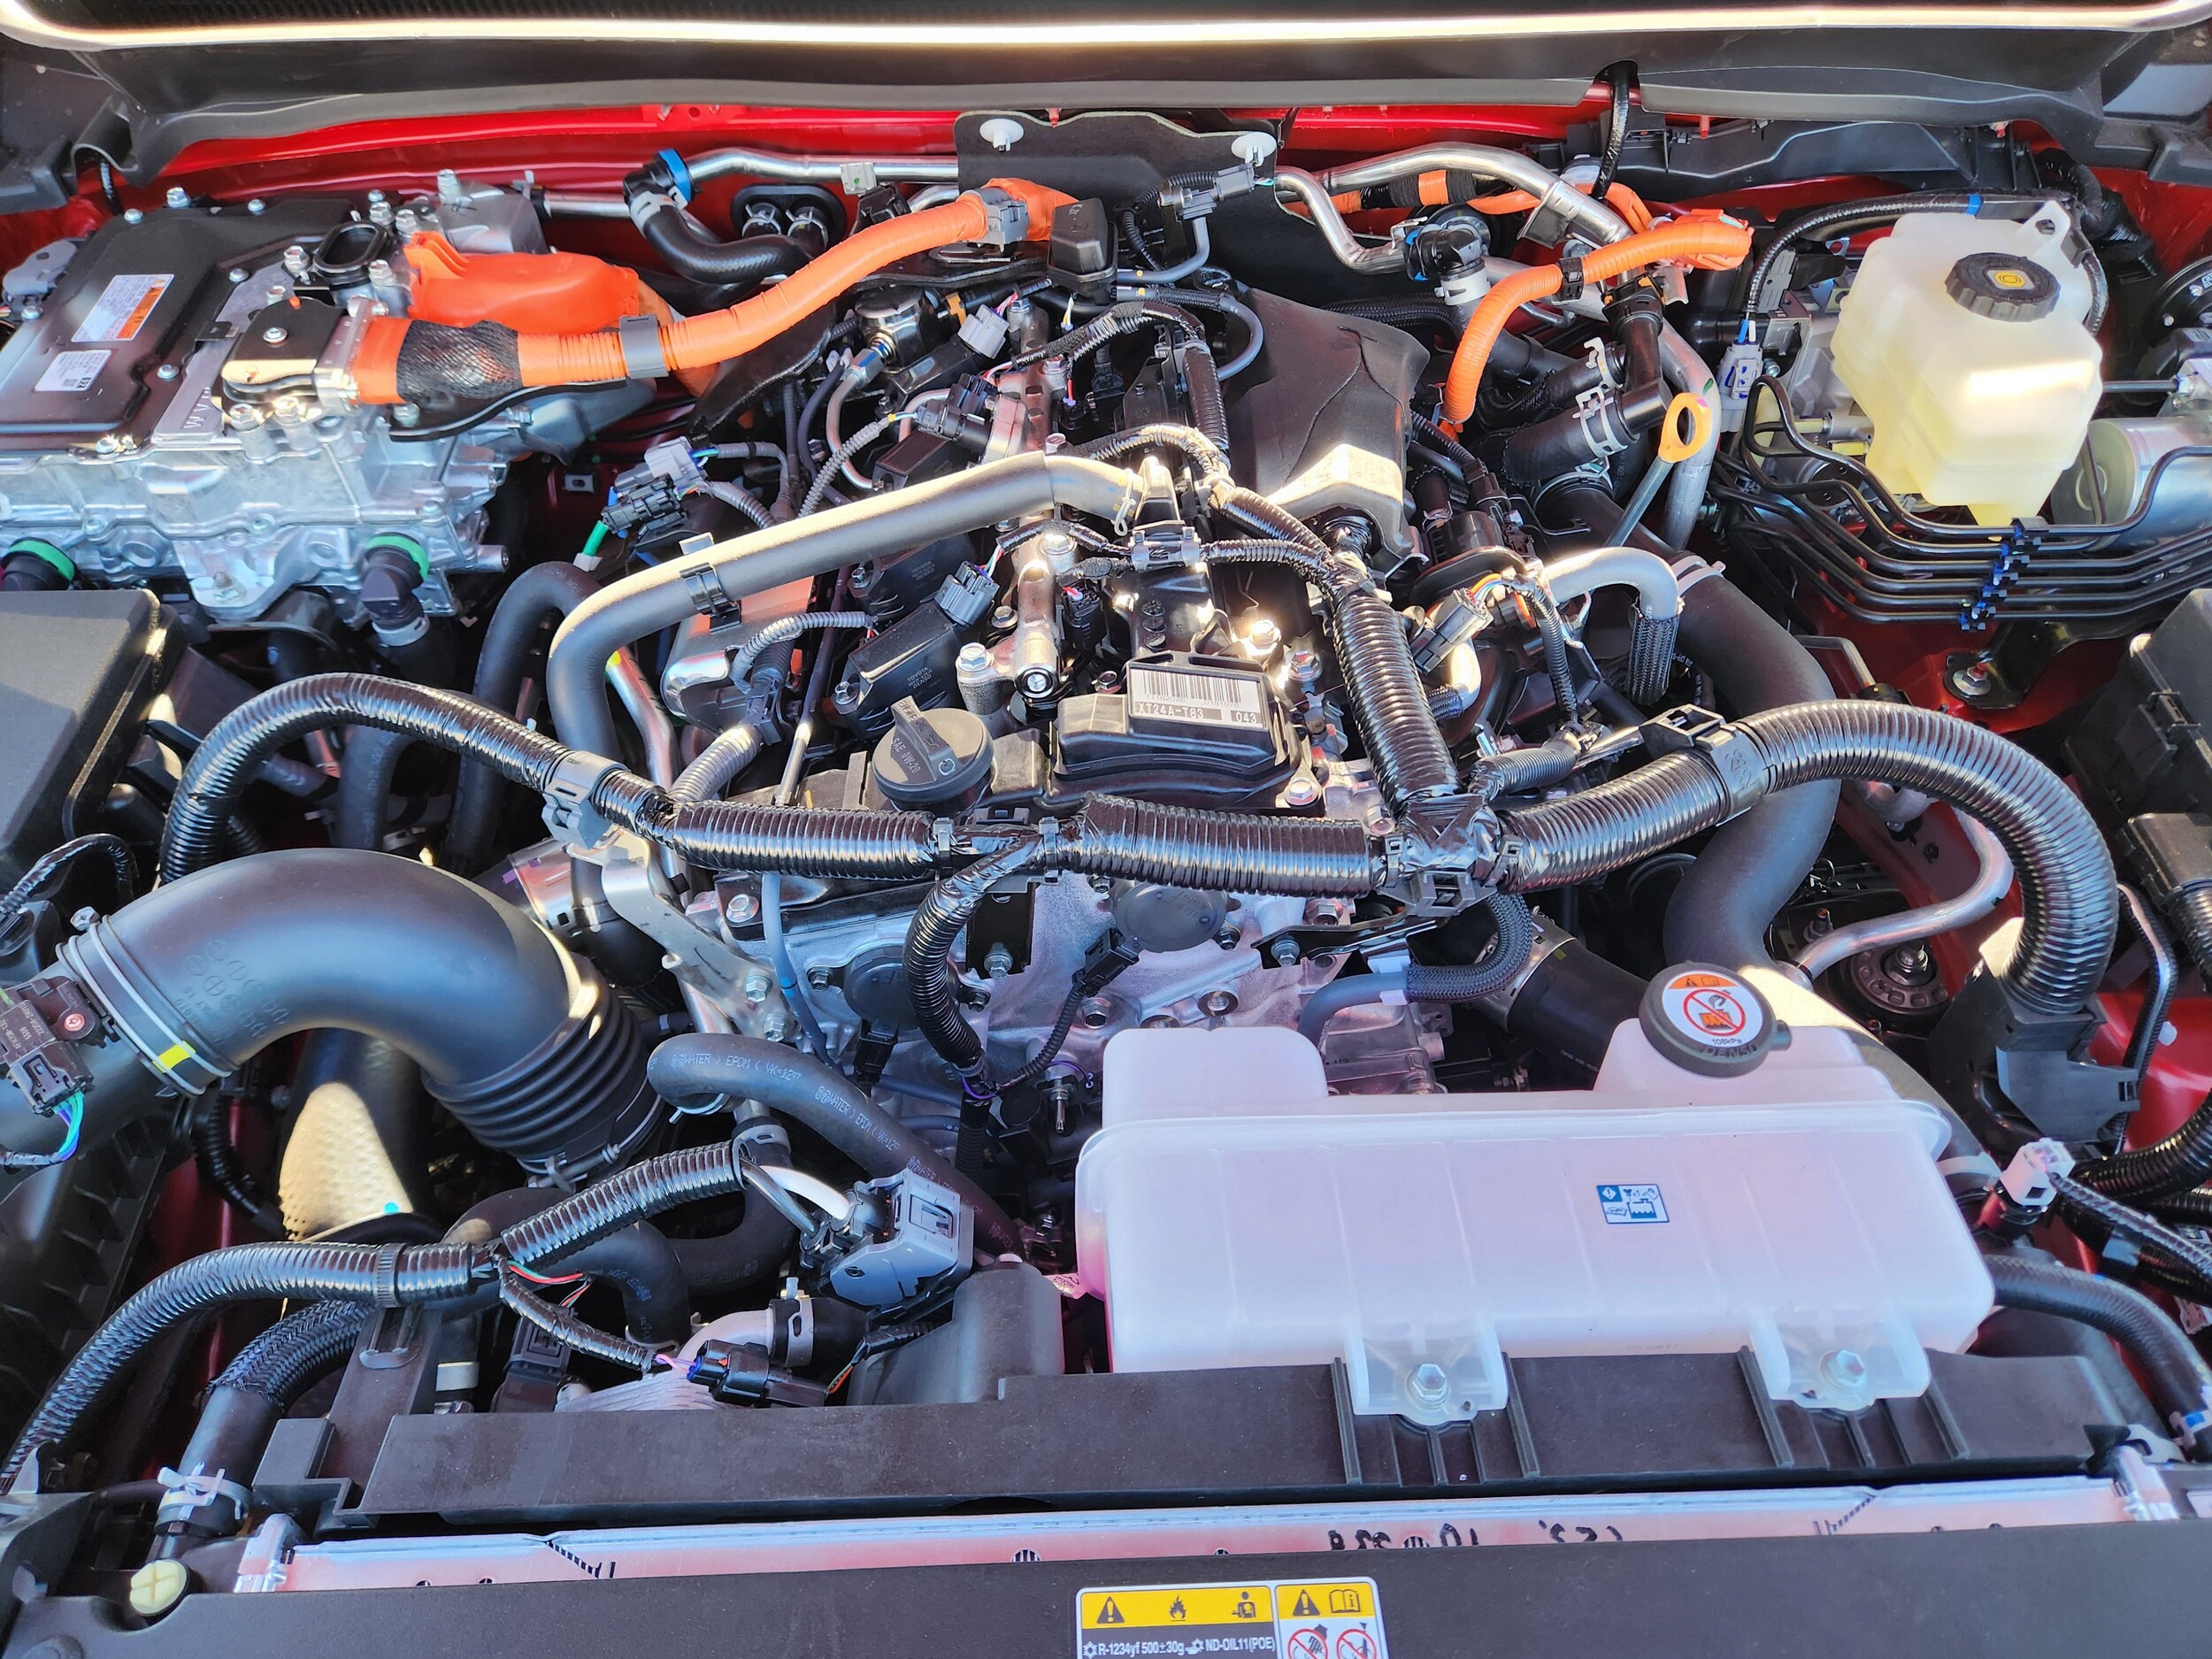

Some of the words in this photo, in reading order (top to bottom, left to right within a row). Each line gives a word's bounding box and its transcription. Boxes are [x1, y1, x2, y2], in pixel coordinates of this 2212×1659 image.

[907, 666, 929, 682] TOYOTA
[912, 673, 933, 689] DENSO
[1138, 702, 1204, 719] XT24A-T83
[1236, 711, 1257, 724] 043
[892, 737, 907, 753] SAE
[901, 751, 921, 774] 0W-20
[1704, 1043, 1757, 1057] DENSO
[1098, 1641, 1141, 1657] R-1234yf
[1141, 1641, 1185, 1656] 500±30g
[1205, 1637, 1276, 1653] ND-OIL11(POE)
